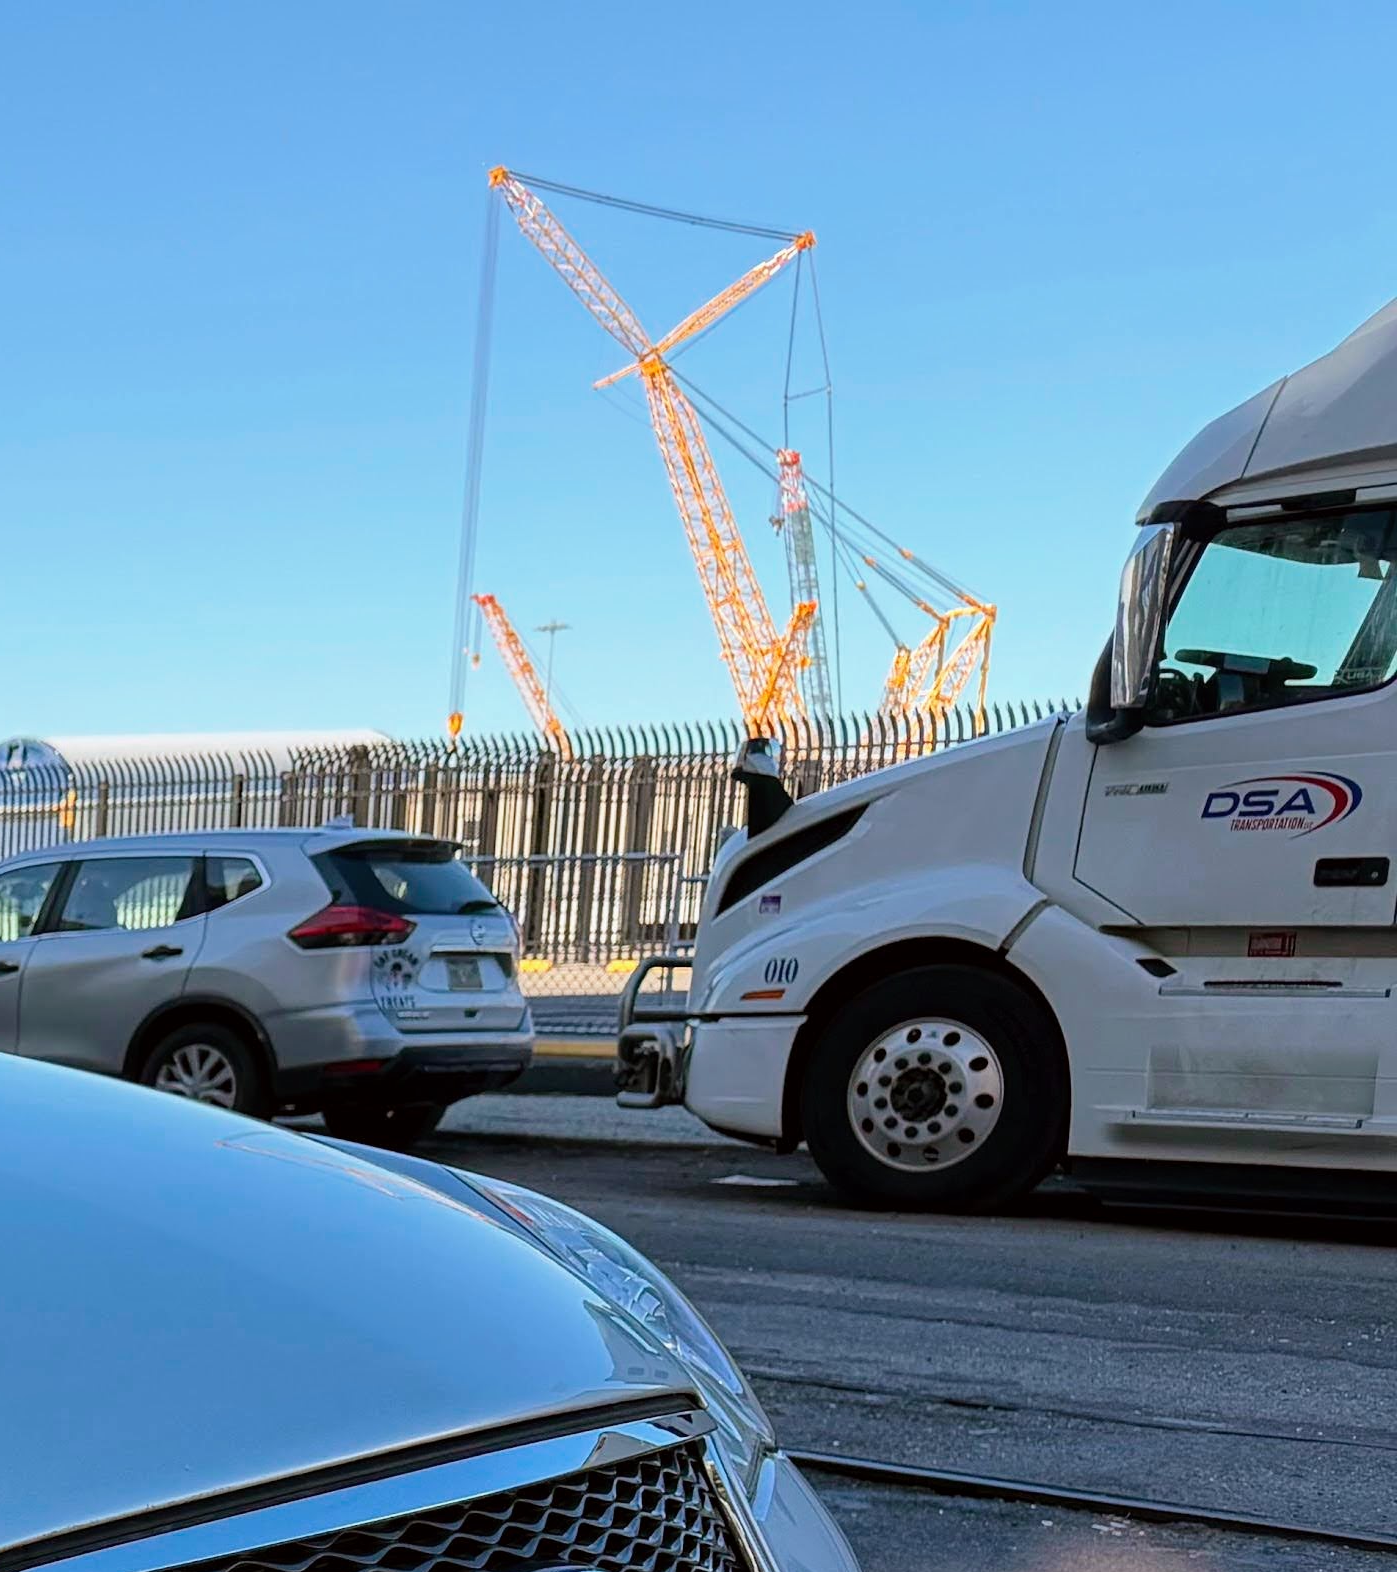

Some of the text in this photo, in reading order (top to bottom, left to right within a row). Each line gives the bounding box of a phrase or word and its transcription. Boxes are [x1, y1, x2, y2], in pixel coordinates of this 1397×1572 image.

[1201, 787, 1316, 818] DSA
[1230, 817, 1305, 832] TRANSPORTATION
[765, 957, 799, 984] 010
